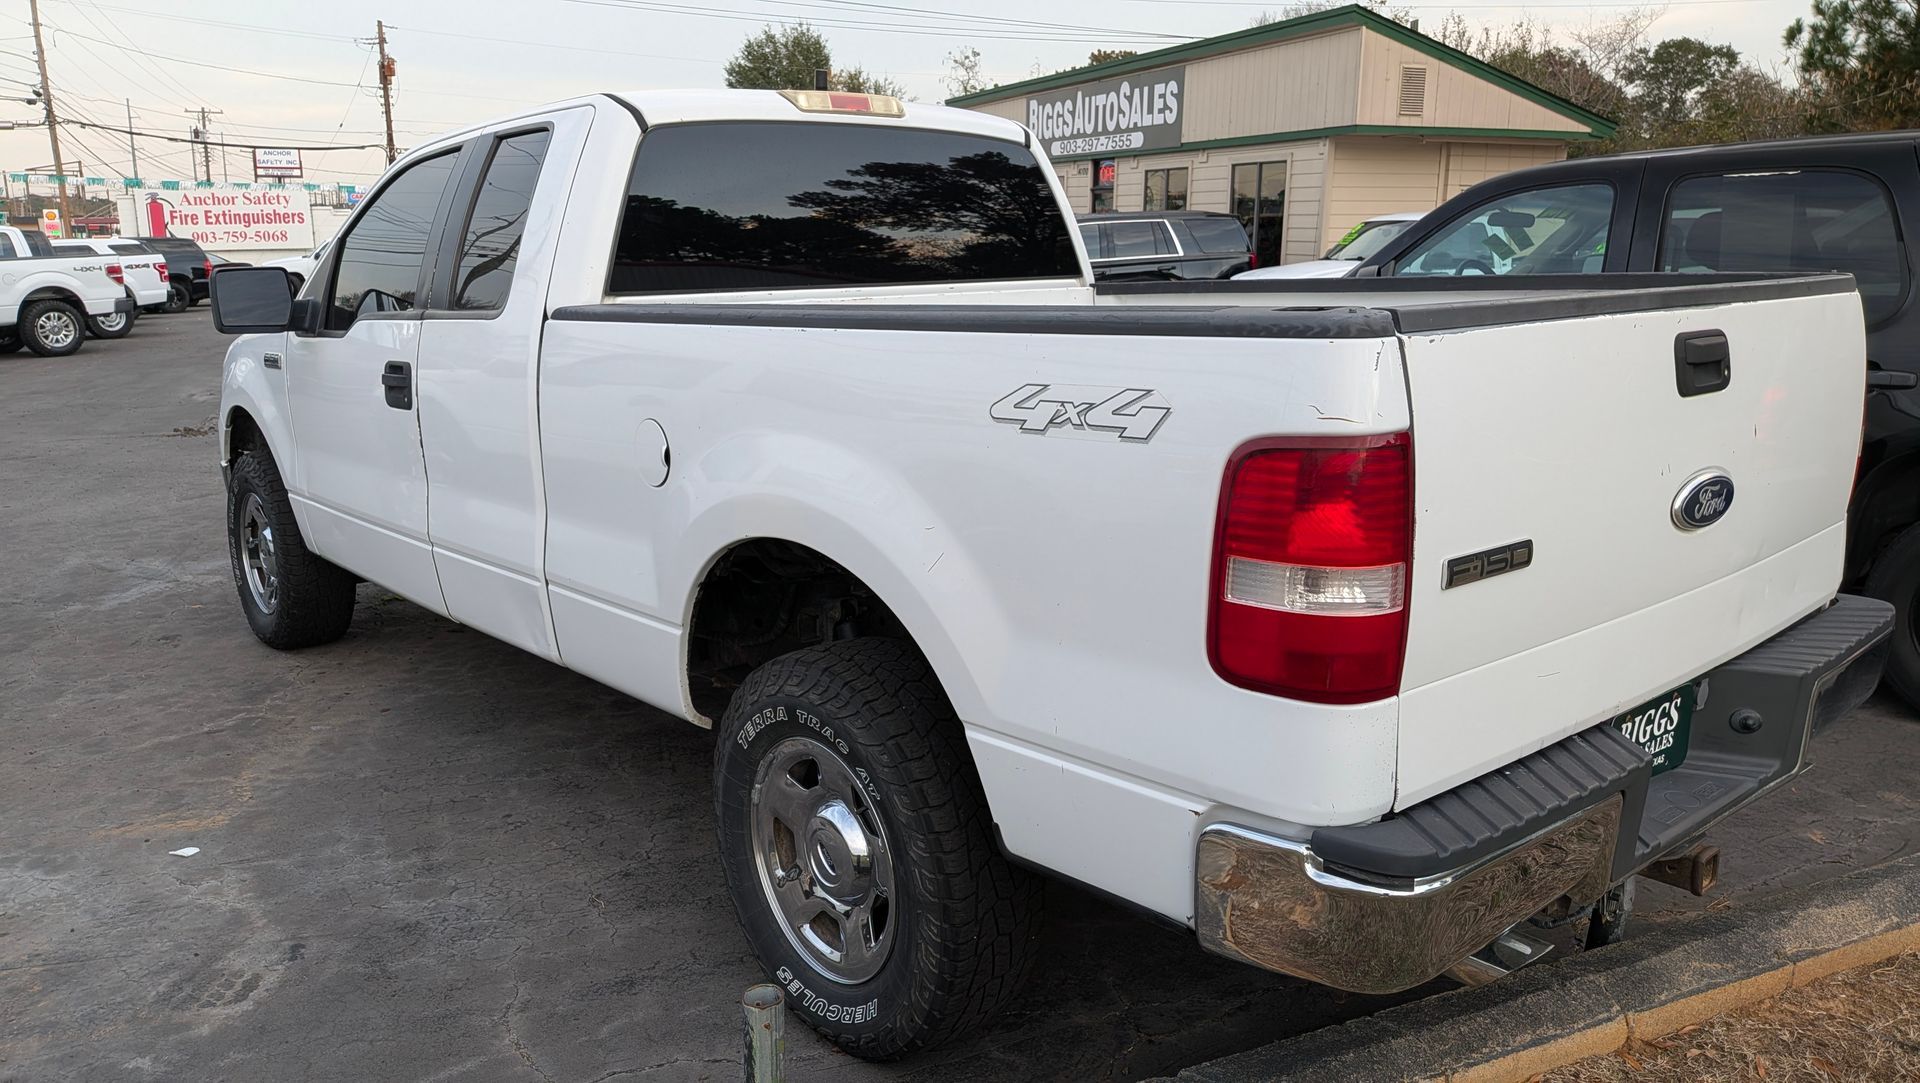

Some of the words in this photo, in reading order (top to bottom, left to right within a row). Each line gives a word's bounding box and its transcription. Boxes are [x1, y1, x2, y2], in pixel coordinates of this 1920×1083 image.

[1059, 134, 1133, 154] 903-297-7555
[179, 192, 239, 207] Anchor
[242, 191, 292, 209] Safety
[168, 209, 200, 226] Fire
[203, 208, 306, 228] Extinguishers
[191, 229, 289, 244] 903-759-5068
[1694, 483, 1727, 520] Ford
[1449, 545, 1531, 589] F-150
[736, 706, 789, 750] TERRA
[796, 709, 850, 755] TRAC
[776, 966, 879, 1024] HERCULES
